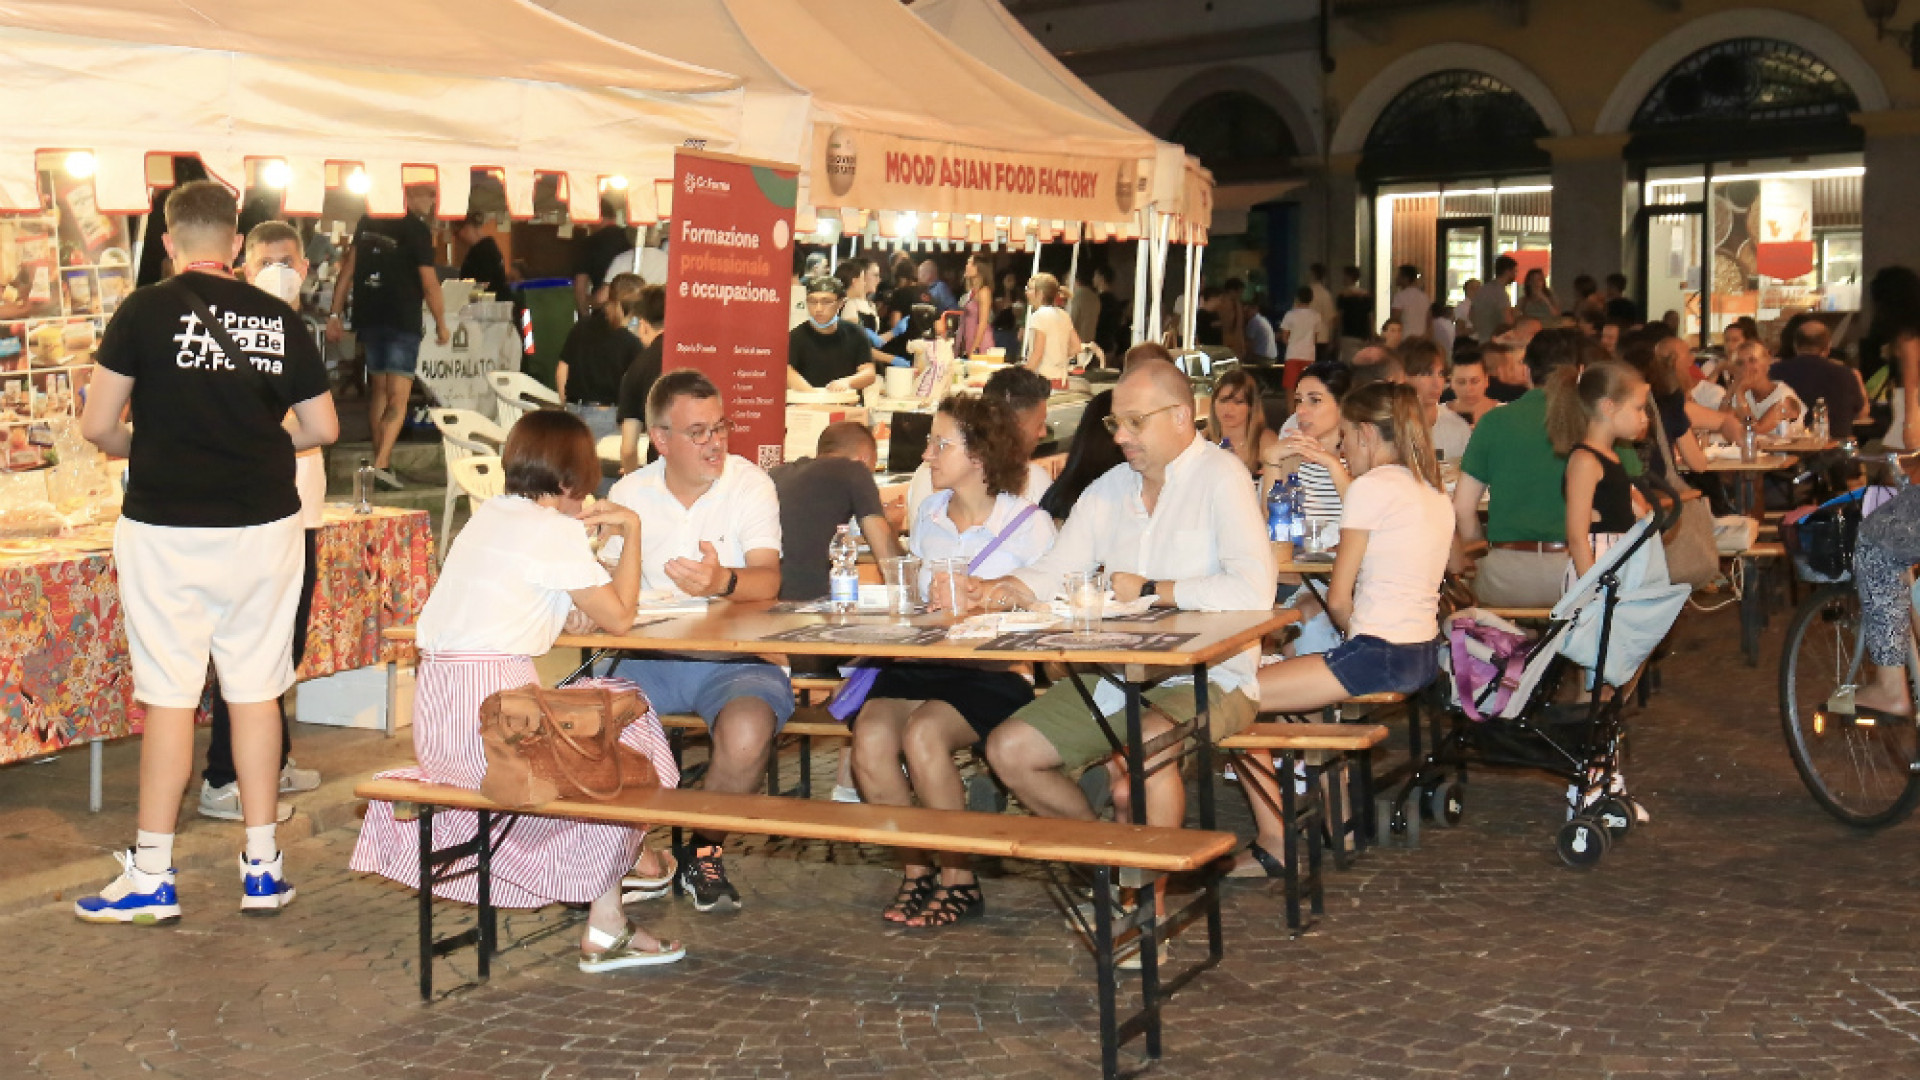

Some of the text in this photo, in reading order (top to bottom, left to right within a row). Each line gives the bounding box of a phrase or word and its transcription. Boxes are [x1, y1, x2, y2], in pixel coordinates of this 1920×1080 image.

[884, 151, 936, 186] MOOD
[938, 156, 992, 190] ASIAN
[994, 162, 1036, 195] FOOD
[1038, 166, 1099, 198] FACTORY
[682, 220, 760, 249] Formazione
[680, 250, 771, 277] professionale
[679, 280, 781, 306] e occupazione.
[255, 333, 282, 351] Be
[176, 350, 283, 375] Cr.Foma
[421, 360, 452, 379] BUON
